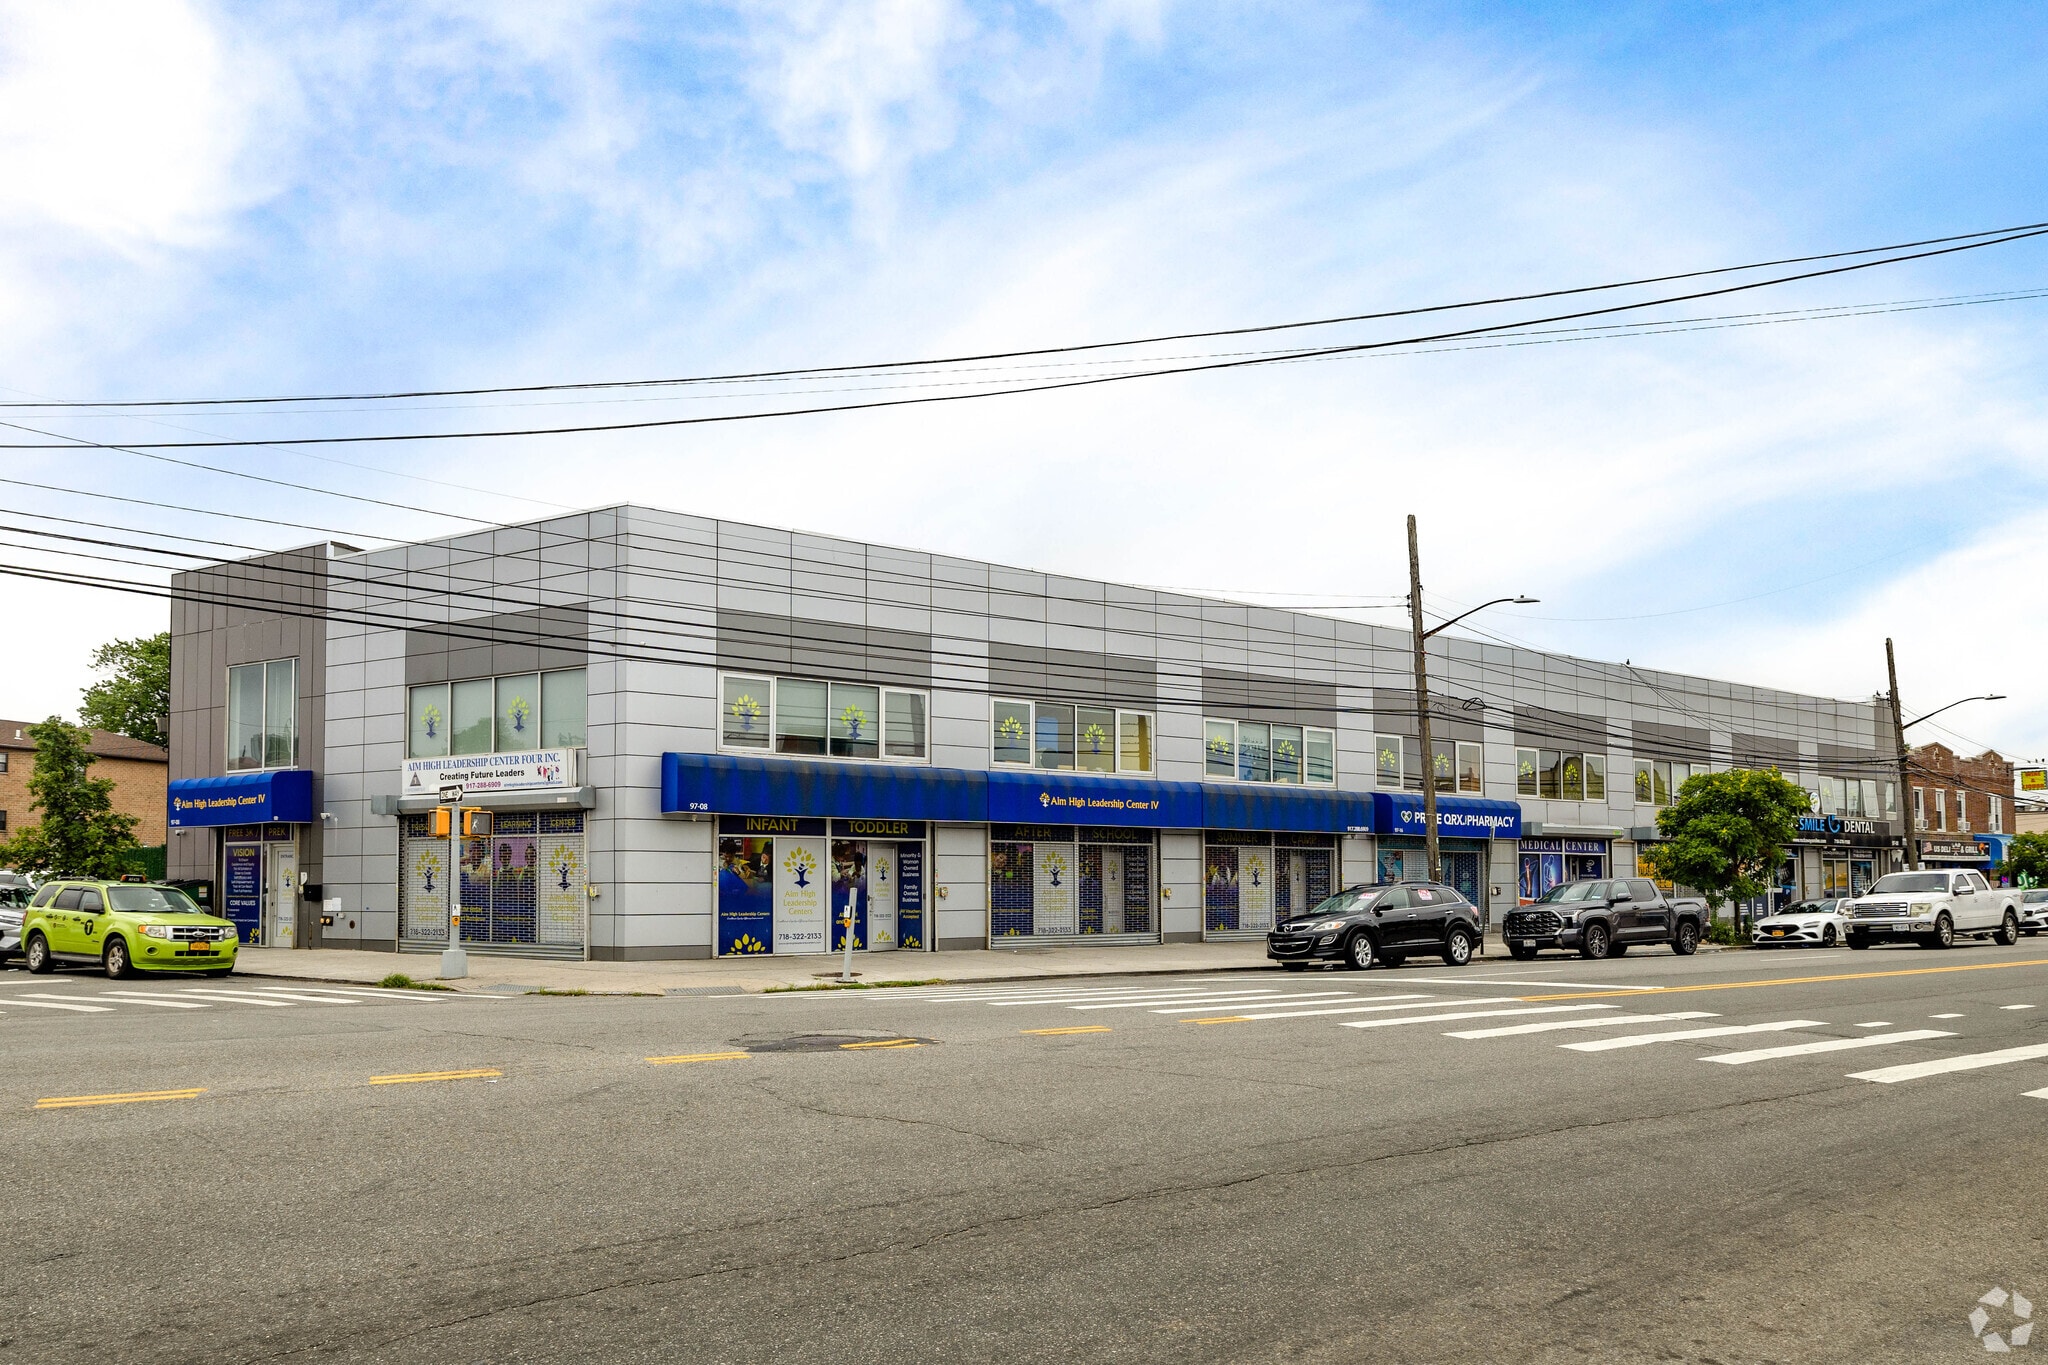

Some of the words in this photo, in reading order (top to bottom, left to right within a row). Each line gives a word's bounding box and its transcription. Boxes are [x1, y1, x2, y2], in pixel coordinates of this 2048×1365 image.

[408, 762, 421, 771] AIM
[423, 760, 441, 770] HIGH
[443, 758, 488, 769] LEADERSHIP
[490, 755, 519, 766] CENTER
[522, 754, 543, 764] FOUR
[545, 753, 560, 762] INC.
[440, 772, 468, 781] Creating
[471, 771, 493, 779] Future
[496, 769, 525, 778] Leaders
[466, 781, 501, 789] 917-288-6909
[181, 800, 193, 808] Aim
[194, 799, 207, 810] High
[208, 796, 237, 807] Leadership
[238, 795, 257, 805] Center
[258, 794, 265, 803] IV
[1051, 796, 1066, 806] Aim
[1068, 797, 1085, 809] High
[1088, 798, 1124, 809] Leadership
[1126, 800, 1149, 809] Center
[1151, 801, 1159, 809] IV
[500, 820, 532, 828] LEARNING
[551, 818, 576, 827] CENTER
[1414, 812, 1442, 825] PRE
[746, 818, 798, 832] INFANT
[848, 820, 908, 834] TODDLER
[1799, 818, 1825, 831] SMILE
[1844, 821, 1875, 834] DENTAL
[228, 829, 243, 837] FREE
[268, 827, 286, 836] PREK
[1014, 826, 1051, 838] AFTER
[1092, 828, 1137, 839] SCHOOL
[1217, 831, 1258, 843] SUMMER
[1520, 840, 1561, 851] MEDICAL
[1565, 841, 1599, 852] CENTER
[233, 848, 255, 857] VISION
[801, 890, 816, 899] High
[783, 899, 817, 908] Leadership
